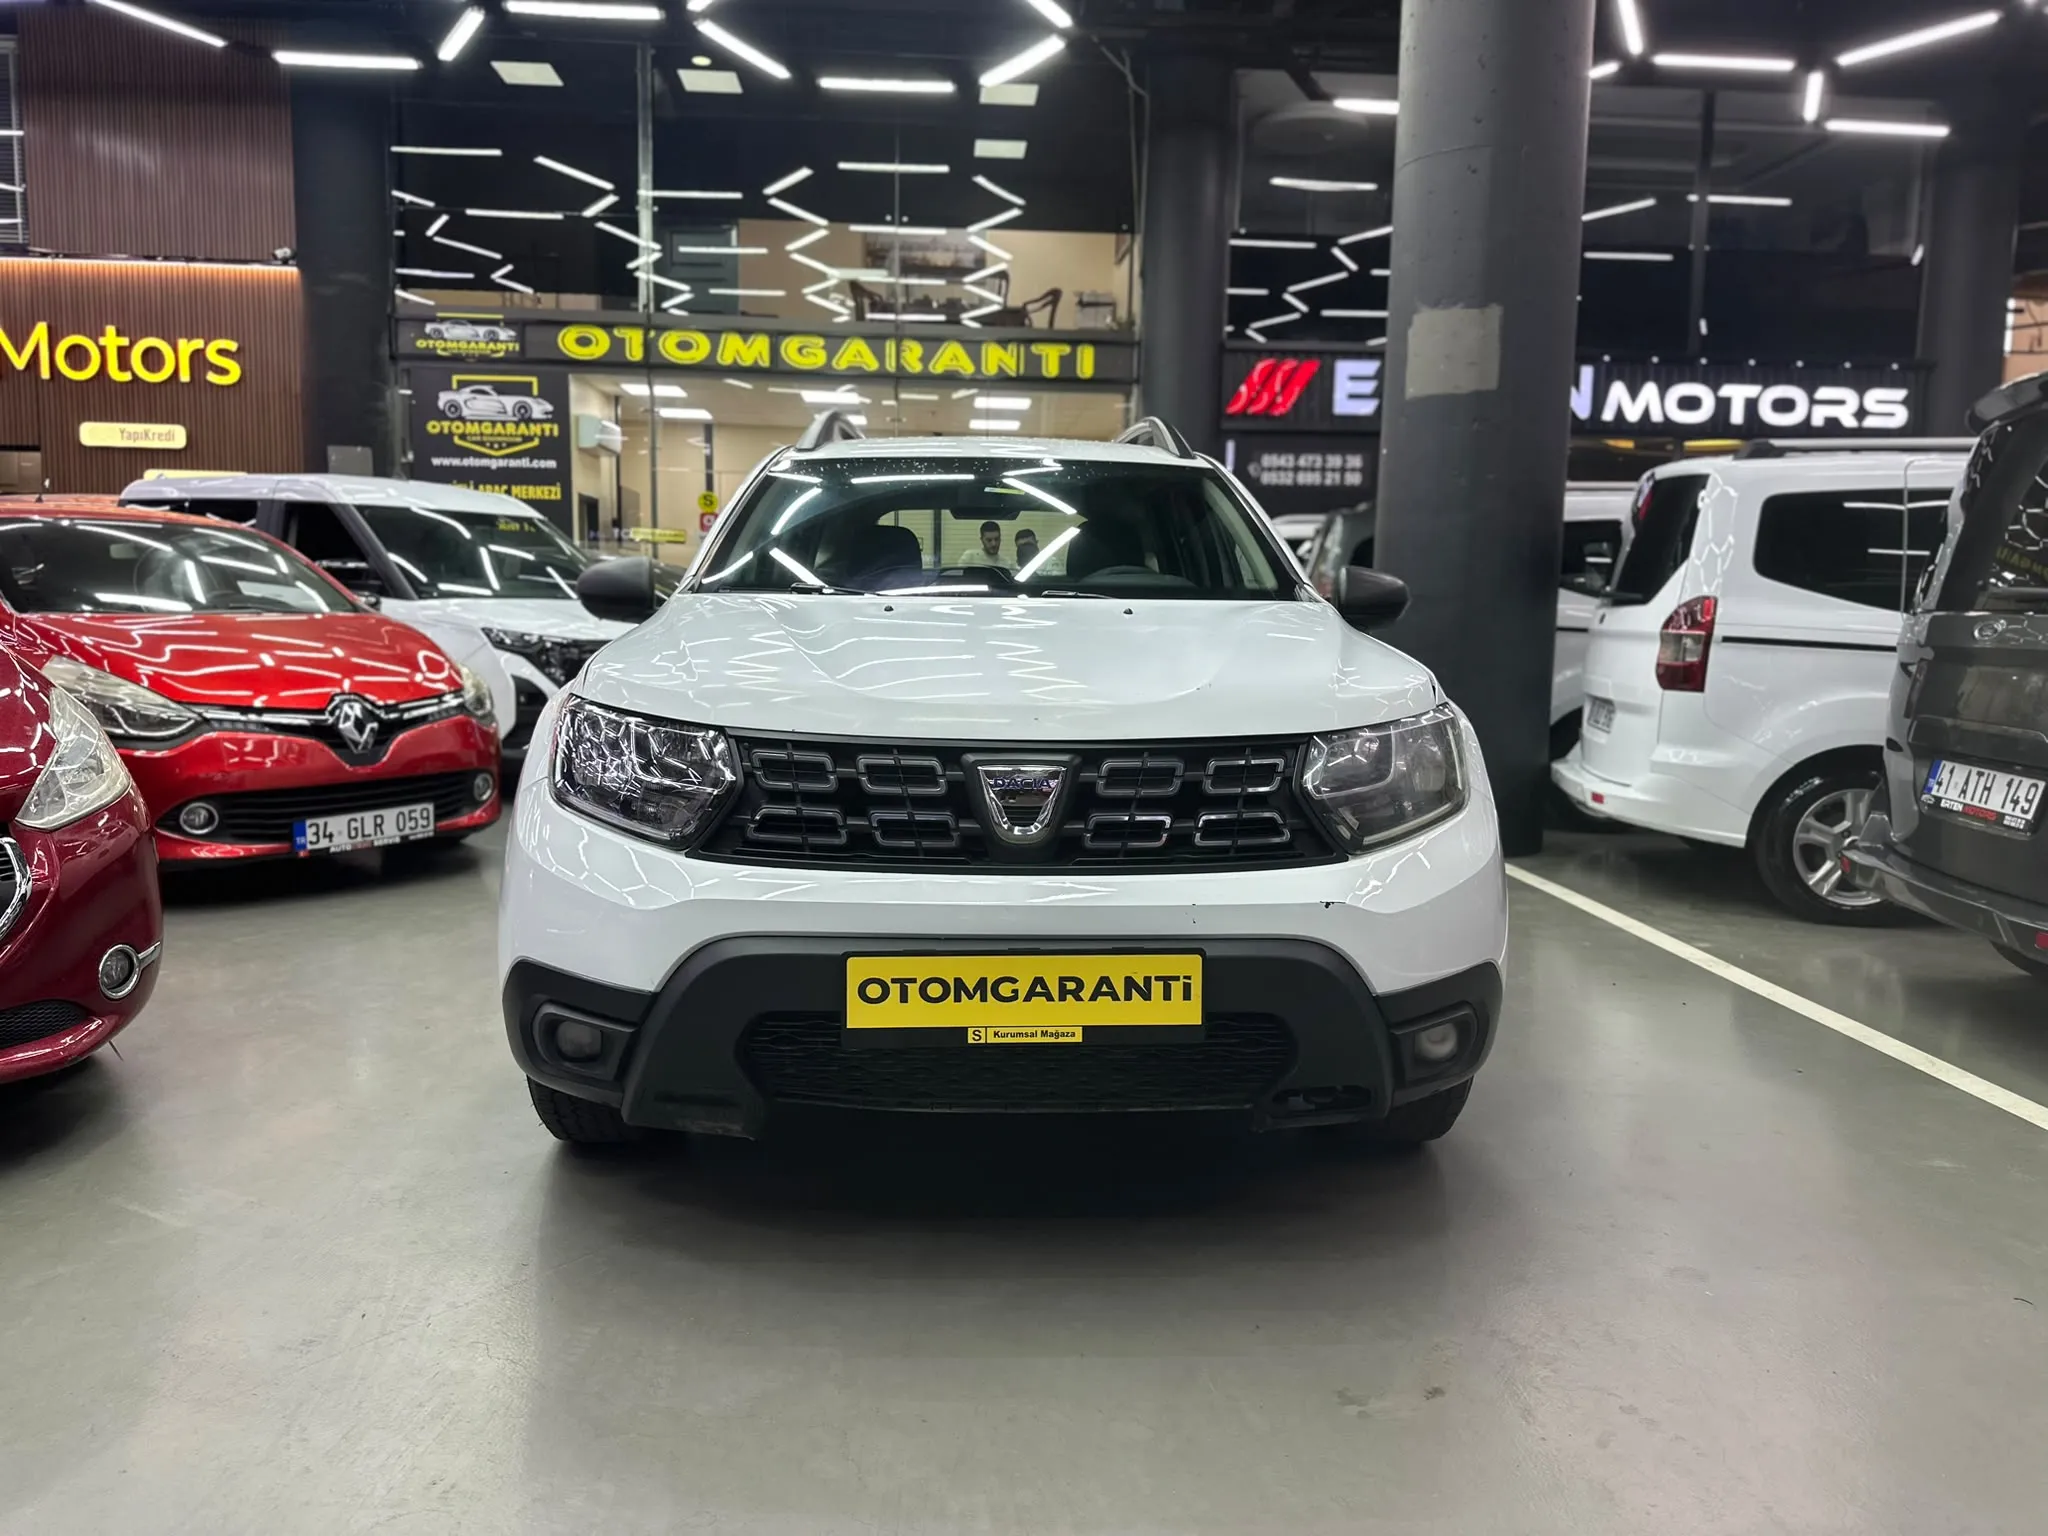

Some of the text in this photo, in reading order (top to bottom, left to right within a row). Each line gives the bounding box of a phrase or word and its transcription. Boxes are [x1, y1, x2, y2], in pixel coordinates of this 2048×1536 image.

[0, 320, 242, 386] Motors
[557, 324, 1097, 381] OTOMGARANTI
[1600, 380, 1910, 430] MOTORS
[426, 419, 560, 437] OTOMGARANTI
[430, 456, 558, 470] www.otomgaranti.com
[992, 776, 1052, 790] DACIA
[1935, 763, 2039, 815] 41 ATH 149
[308, 821, 335, 845] 34
[347, 814, 384, 840] GLR
[396, 808, 430, 832] 059
[972, 1029, 1076, 1042] S Kurumsal Mağaza
